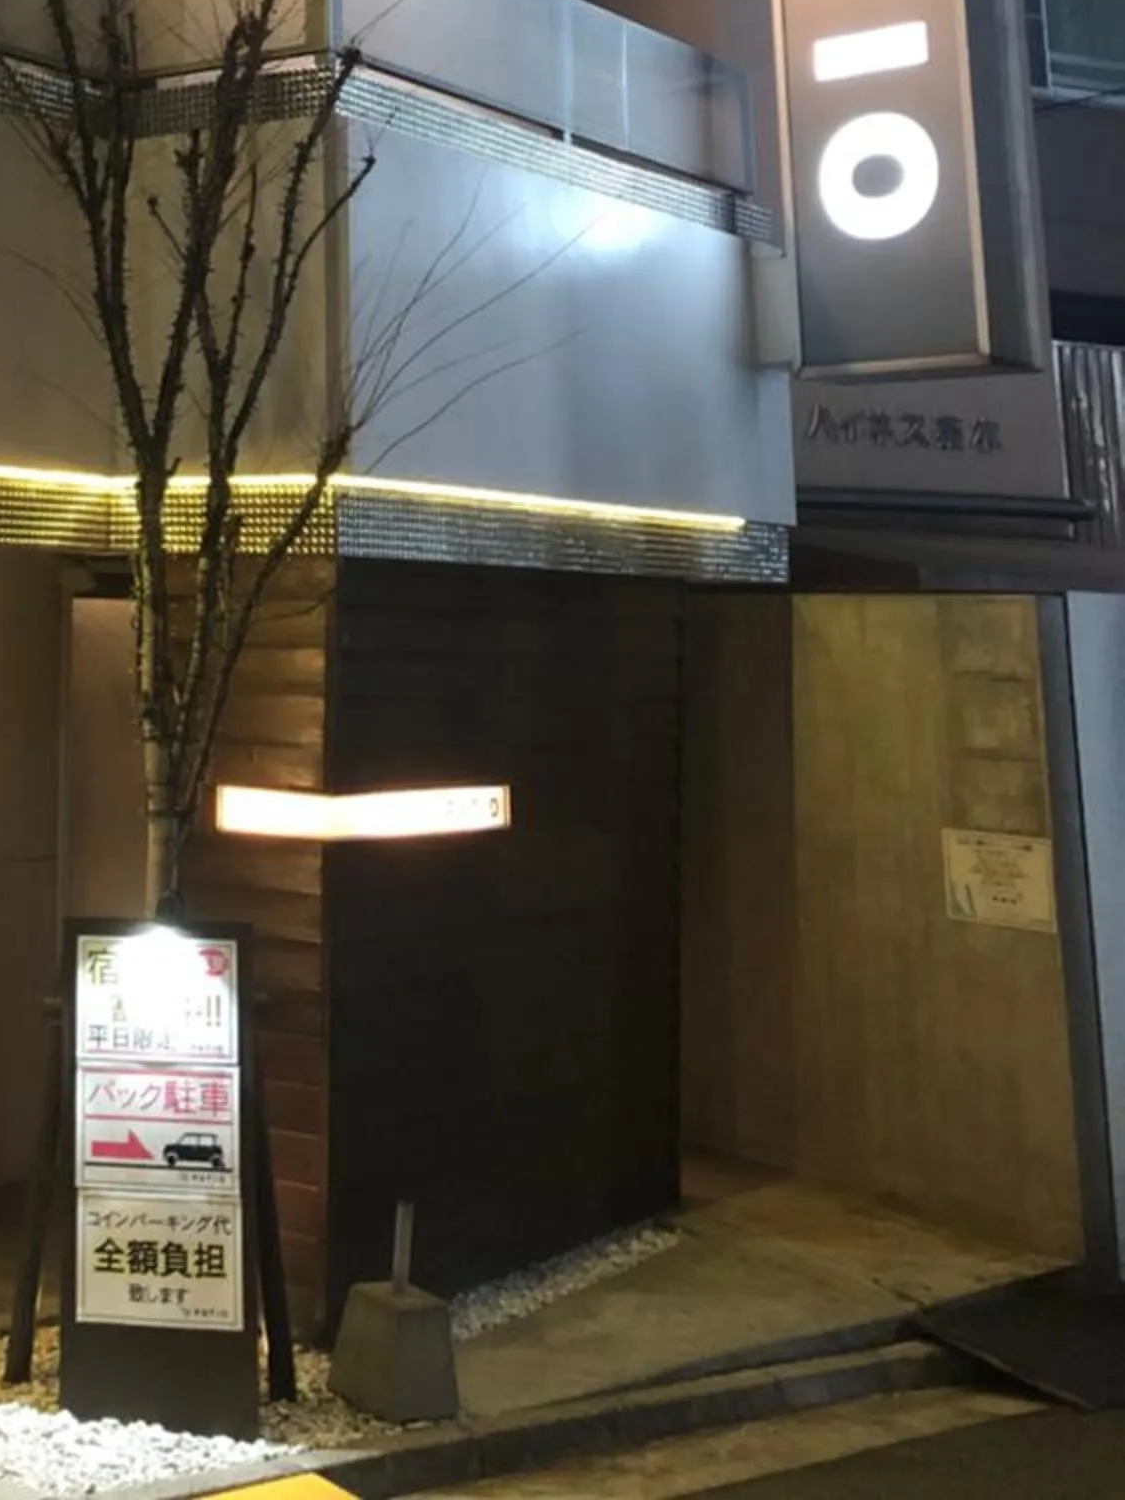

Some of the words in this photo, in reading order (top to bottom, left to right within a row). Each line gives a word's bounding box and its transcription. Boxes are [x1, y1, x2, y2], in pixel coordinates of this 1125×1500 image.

[93, 1237, 228, 1278] 全額負担
[128, 1283, 189, 1303] 致します
